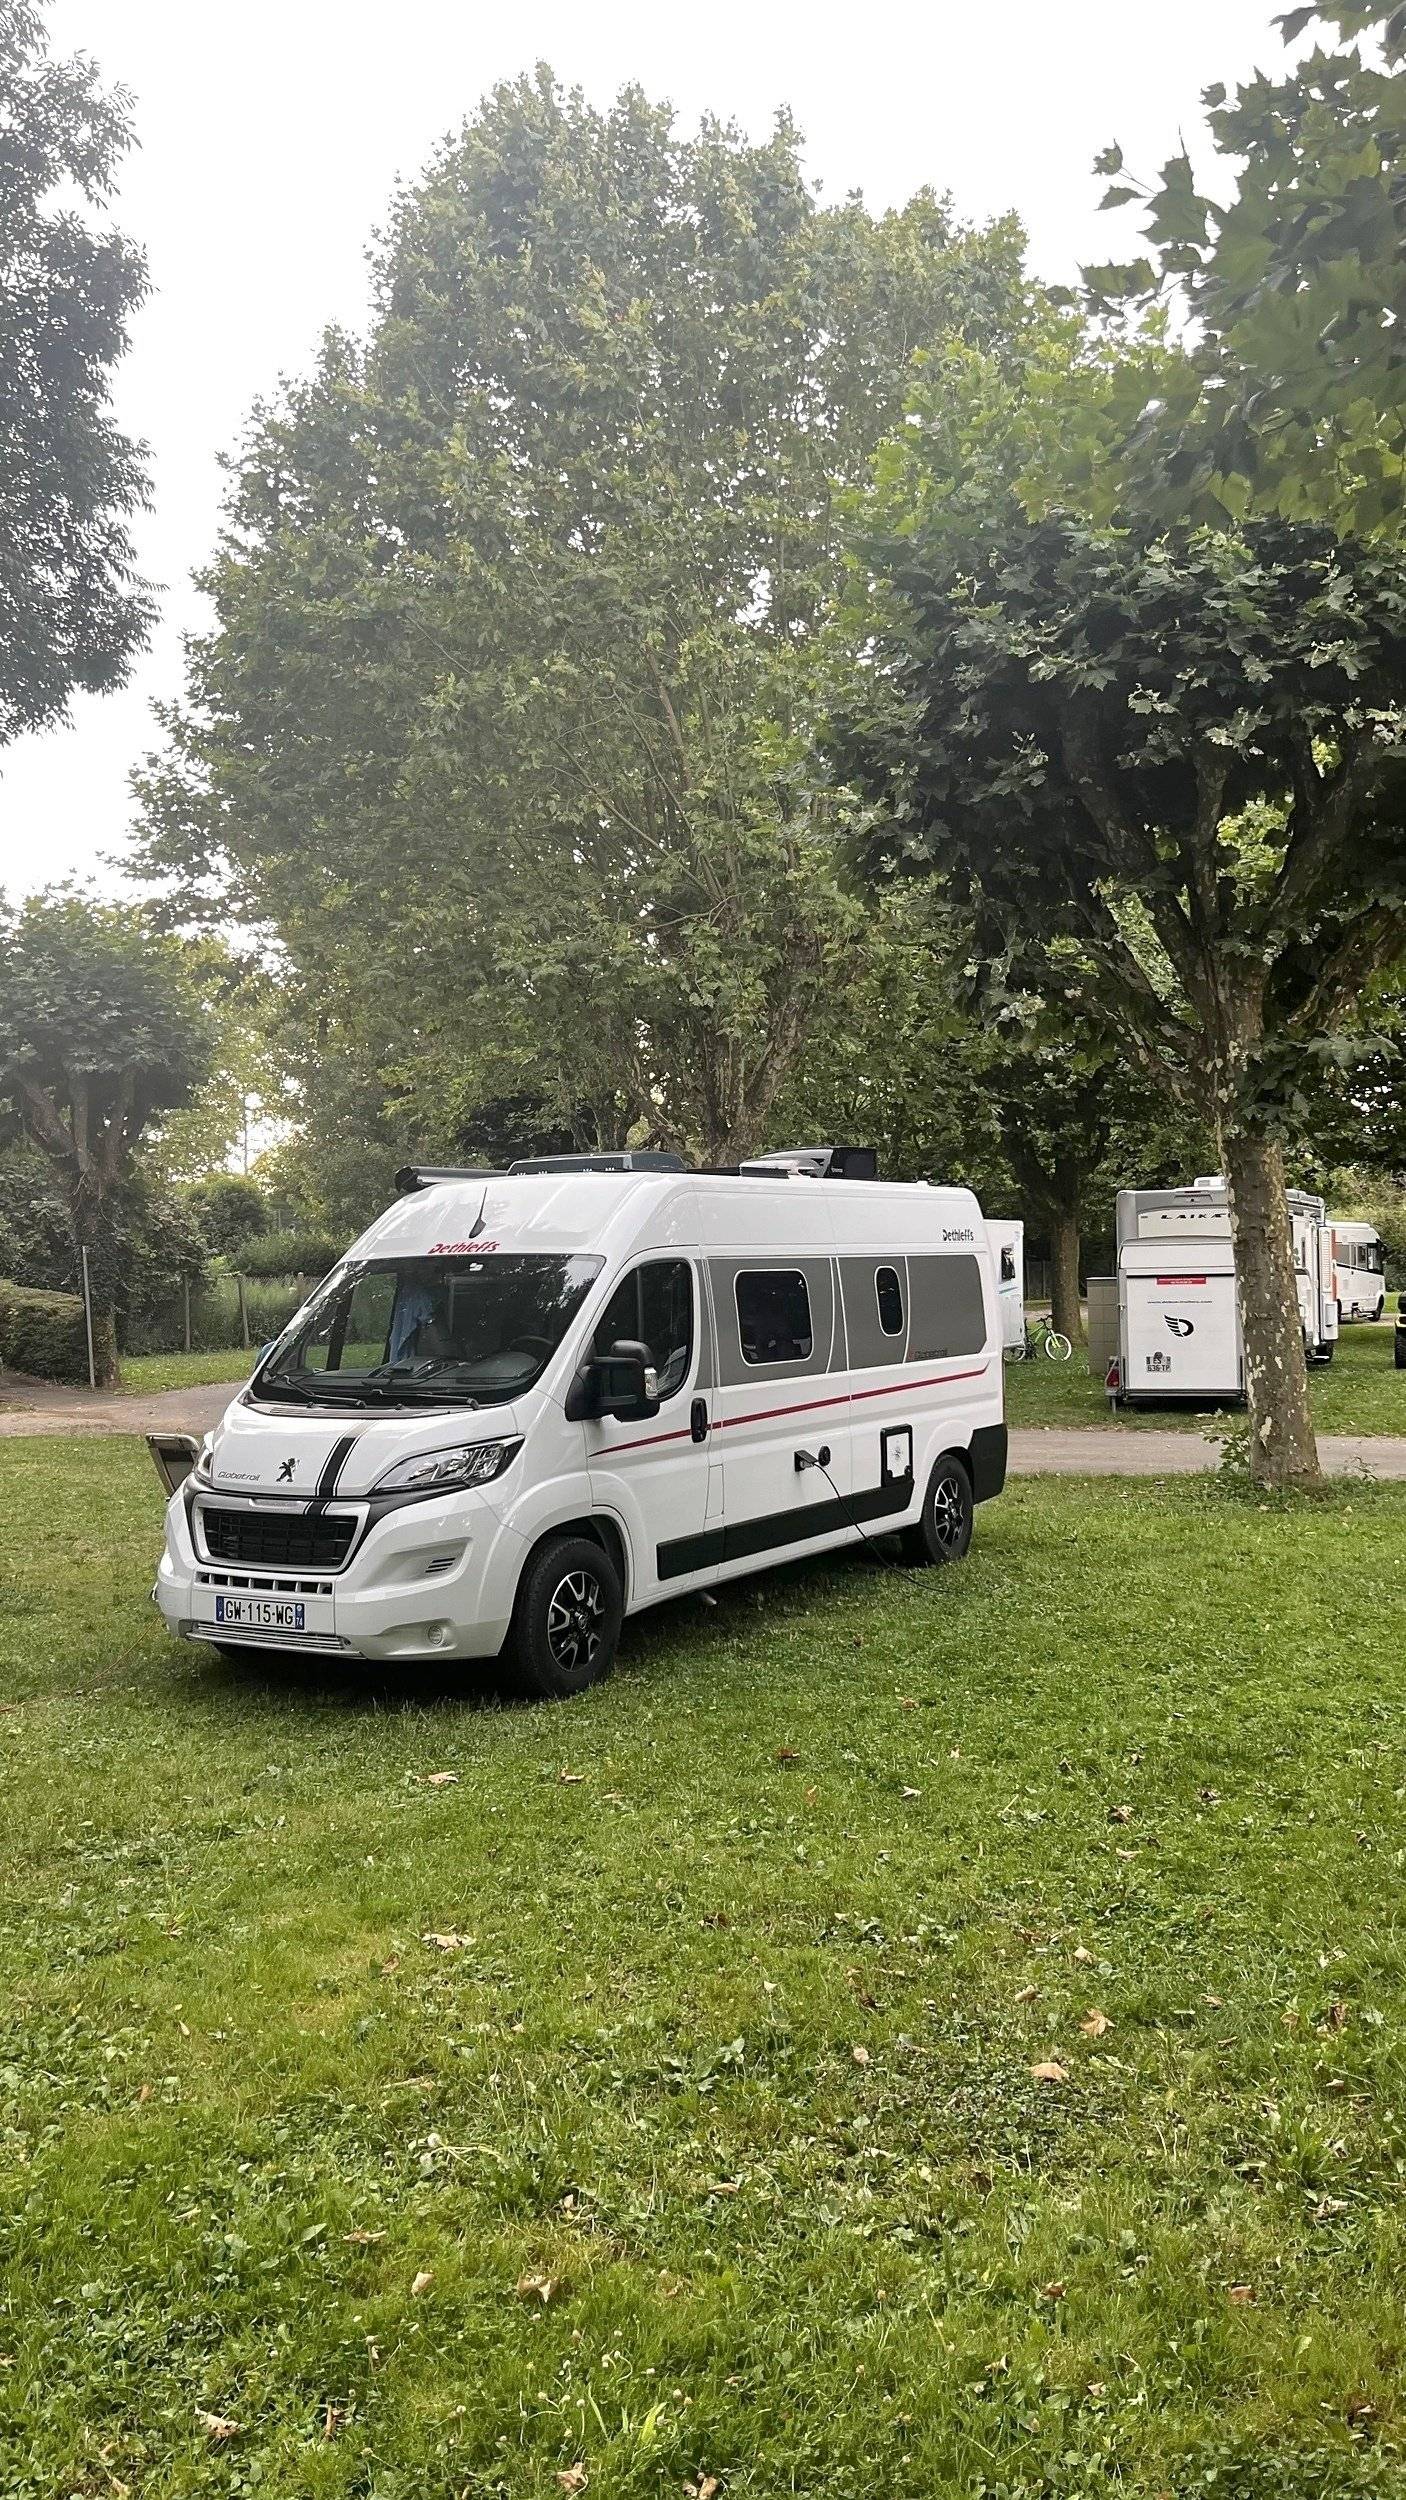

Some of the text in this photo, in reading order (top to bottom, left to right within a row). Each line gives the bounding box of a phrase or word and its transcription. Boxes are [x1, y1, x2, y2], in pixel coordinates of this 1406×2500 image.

[942, 1228, 974, 1241] Dethleffs
[428, 1241, 500, 1254] Dethleffs
[225, 1600, 294, 1625] GW-115-WG
